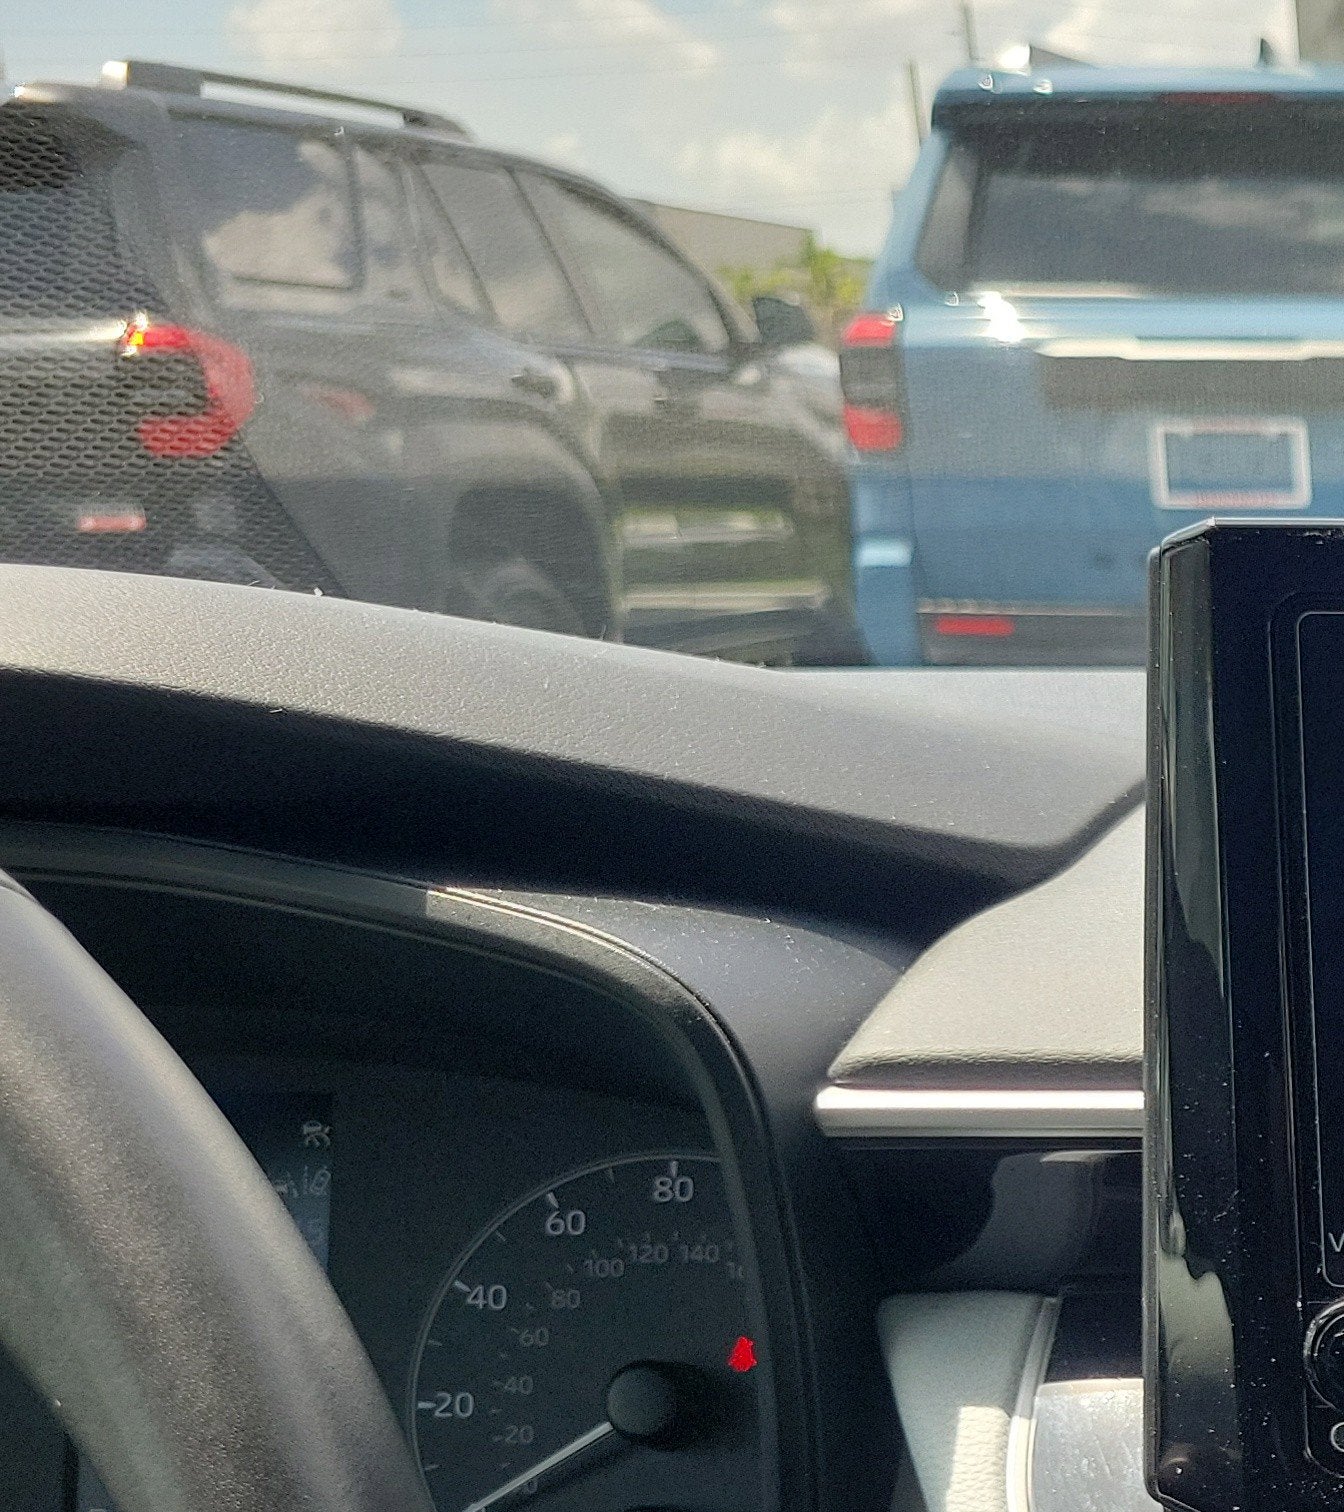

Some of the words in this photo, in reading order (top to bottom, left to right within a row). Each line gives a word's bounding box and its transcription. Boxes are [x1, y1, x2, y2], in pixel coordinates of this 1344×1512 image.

[652, 1176, 696, 1204] 80
[544, 1209, 588, 1237] 60
[465, 1284, 508, 1311] 40
[433, 1392, 475, 1419] 20
[504, 1424, 535, 1445] 20
